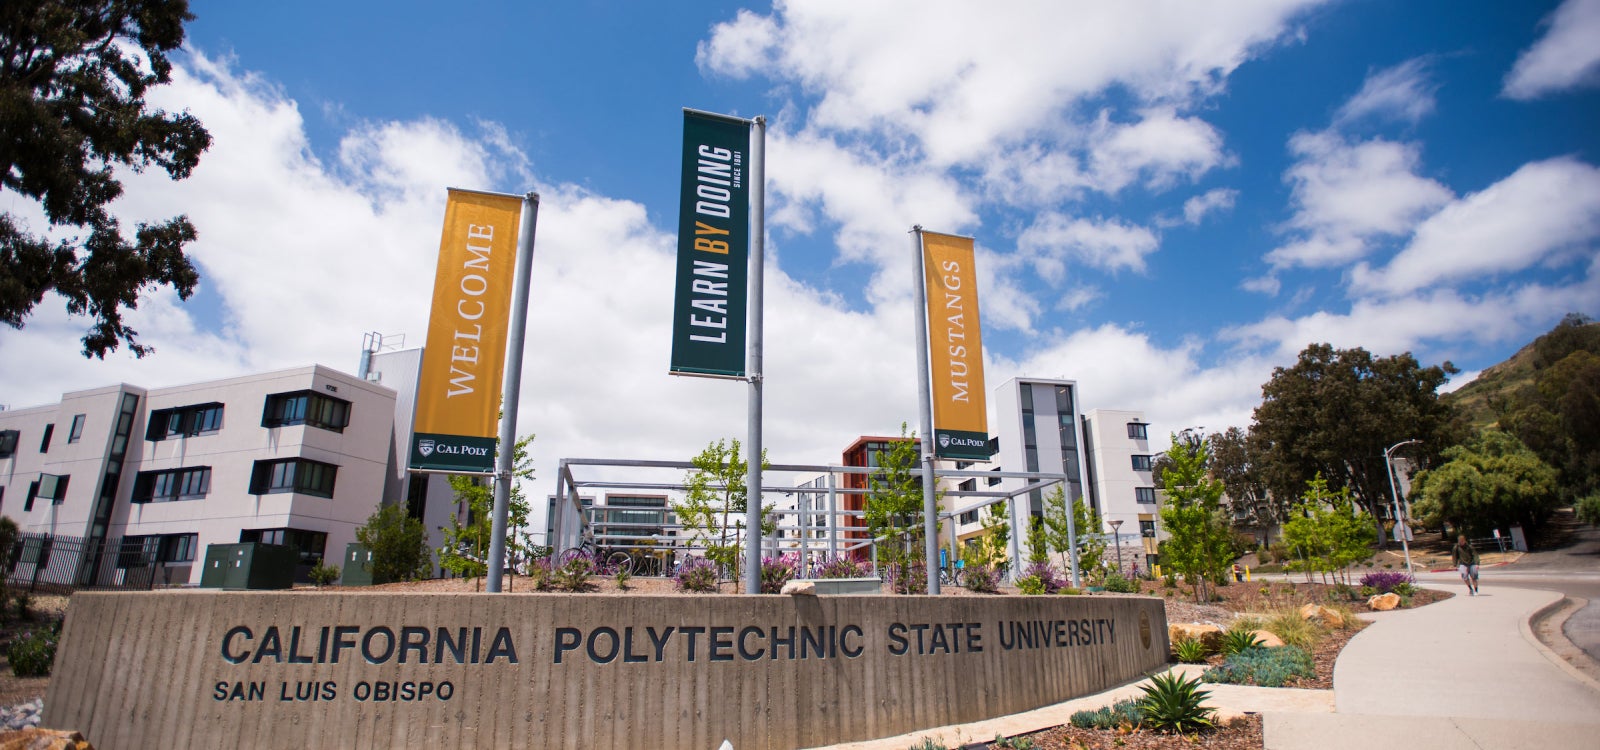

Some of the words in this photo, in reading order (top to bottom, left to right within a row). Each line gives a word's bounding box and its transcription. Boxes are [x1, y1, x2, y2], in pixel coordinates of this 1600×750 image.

[734, 151, 742, 166] 1901
[696, 144, 732, 218] DOING
[733, 167, 741, 188] SINCE
[694, 221, 729, 254] BY
[447, 223, 494, 399] WELCOME
[690, 260, 729, 344] LEARN
[942, 260, 969, 403] MUSTANGS
[436, 443, 460, 454] CAL
[461, 445, 488, 456] POLY
[950, 437, 967, 446] CAL
[967, 438, 985, 447] POLY
[220, 625, 519, 665] CALIFORNIA
[553, 624, 865, 664] POLYTECHNIC
[887, 622, 984, 656] STATE
[999, 618, 1117, 651] UNIVERSITY
[213, 681, 266, 702] SAN
[279, 681, 338, 701] LUIS
[352, 681, 455, 702] OBISPO
